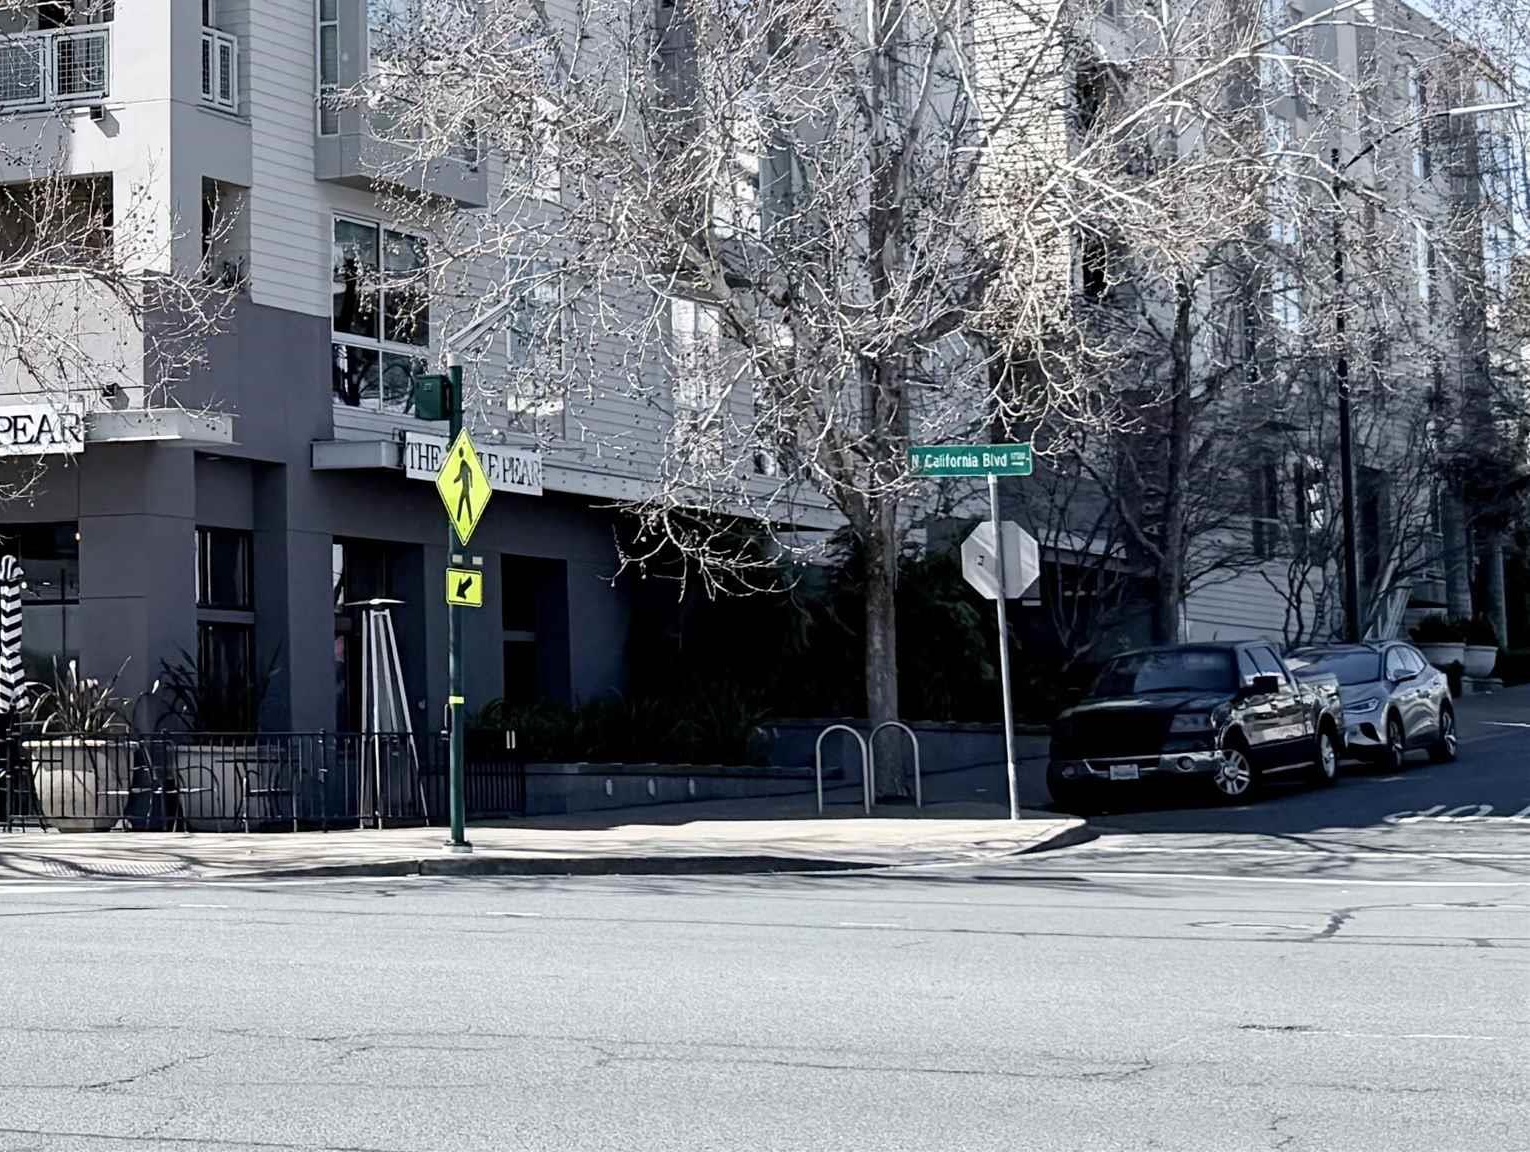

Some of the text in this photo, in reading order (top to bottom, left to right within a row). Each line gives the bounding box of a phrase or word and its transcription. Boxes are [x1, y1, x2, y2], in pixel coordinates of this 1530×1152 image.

[407, 442, 441, 472] THE
[924, 454, 979, 468] California
[982, 453, 1008, 468] Blvd
